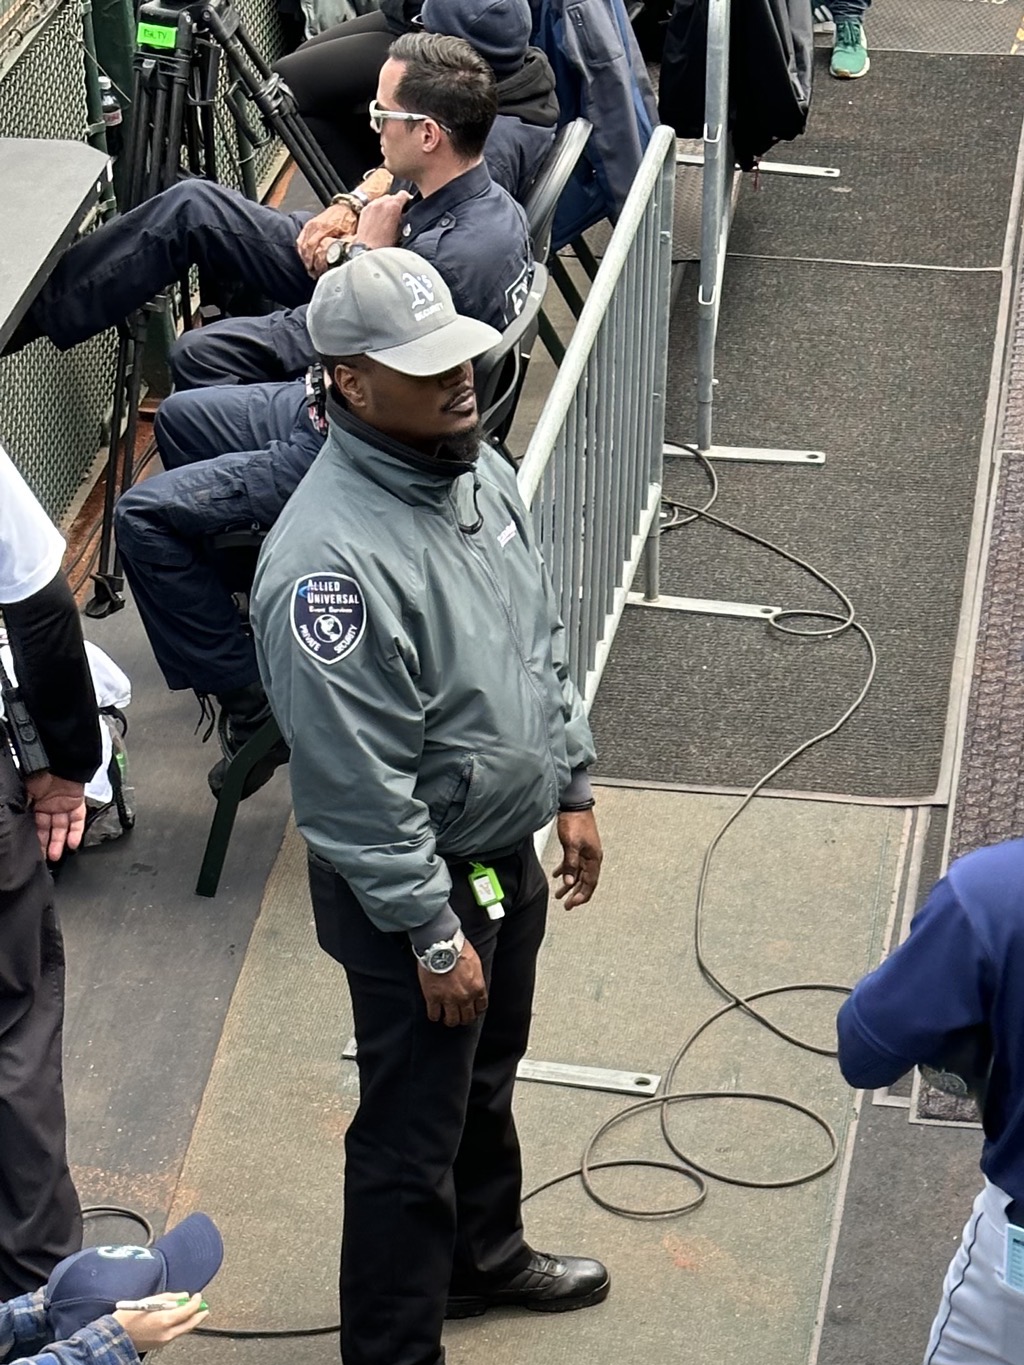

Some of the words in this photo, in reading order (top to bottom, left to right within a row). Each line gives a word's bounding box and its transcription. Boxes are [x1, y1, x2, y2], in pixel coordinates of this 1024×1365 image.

[402, 272, 434, 309] A's
[307, 579, 340, 592] ALLIED
[307, 592, 360, 604] UNIVERSAL
[299, 624, 321, 652] PRIVATE
[333, 624, 358, 654] SECURITY
